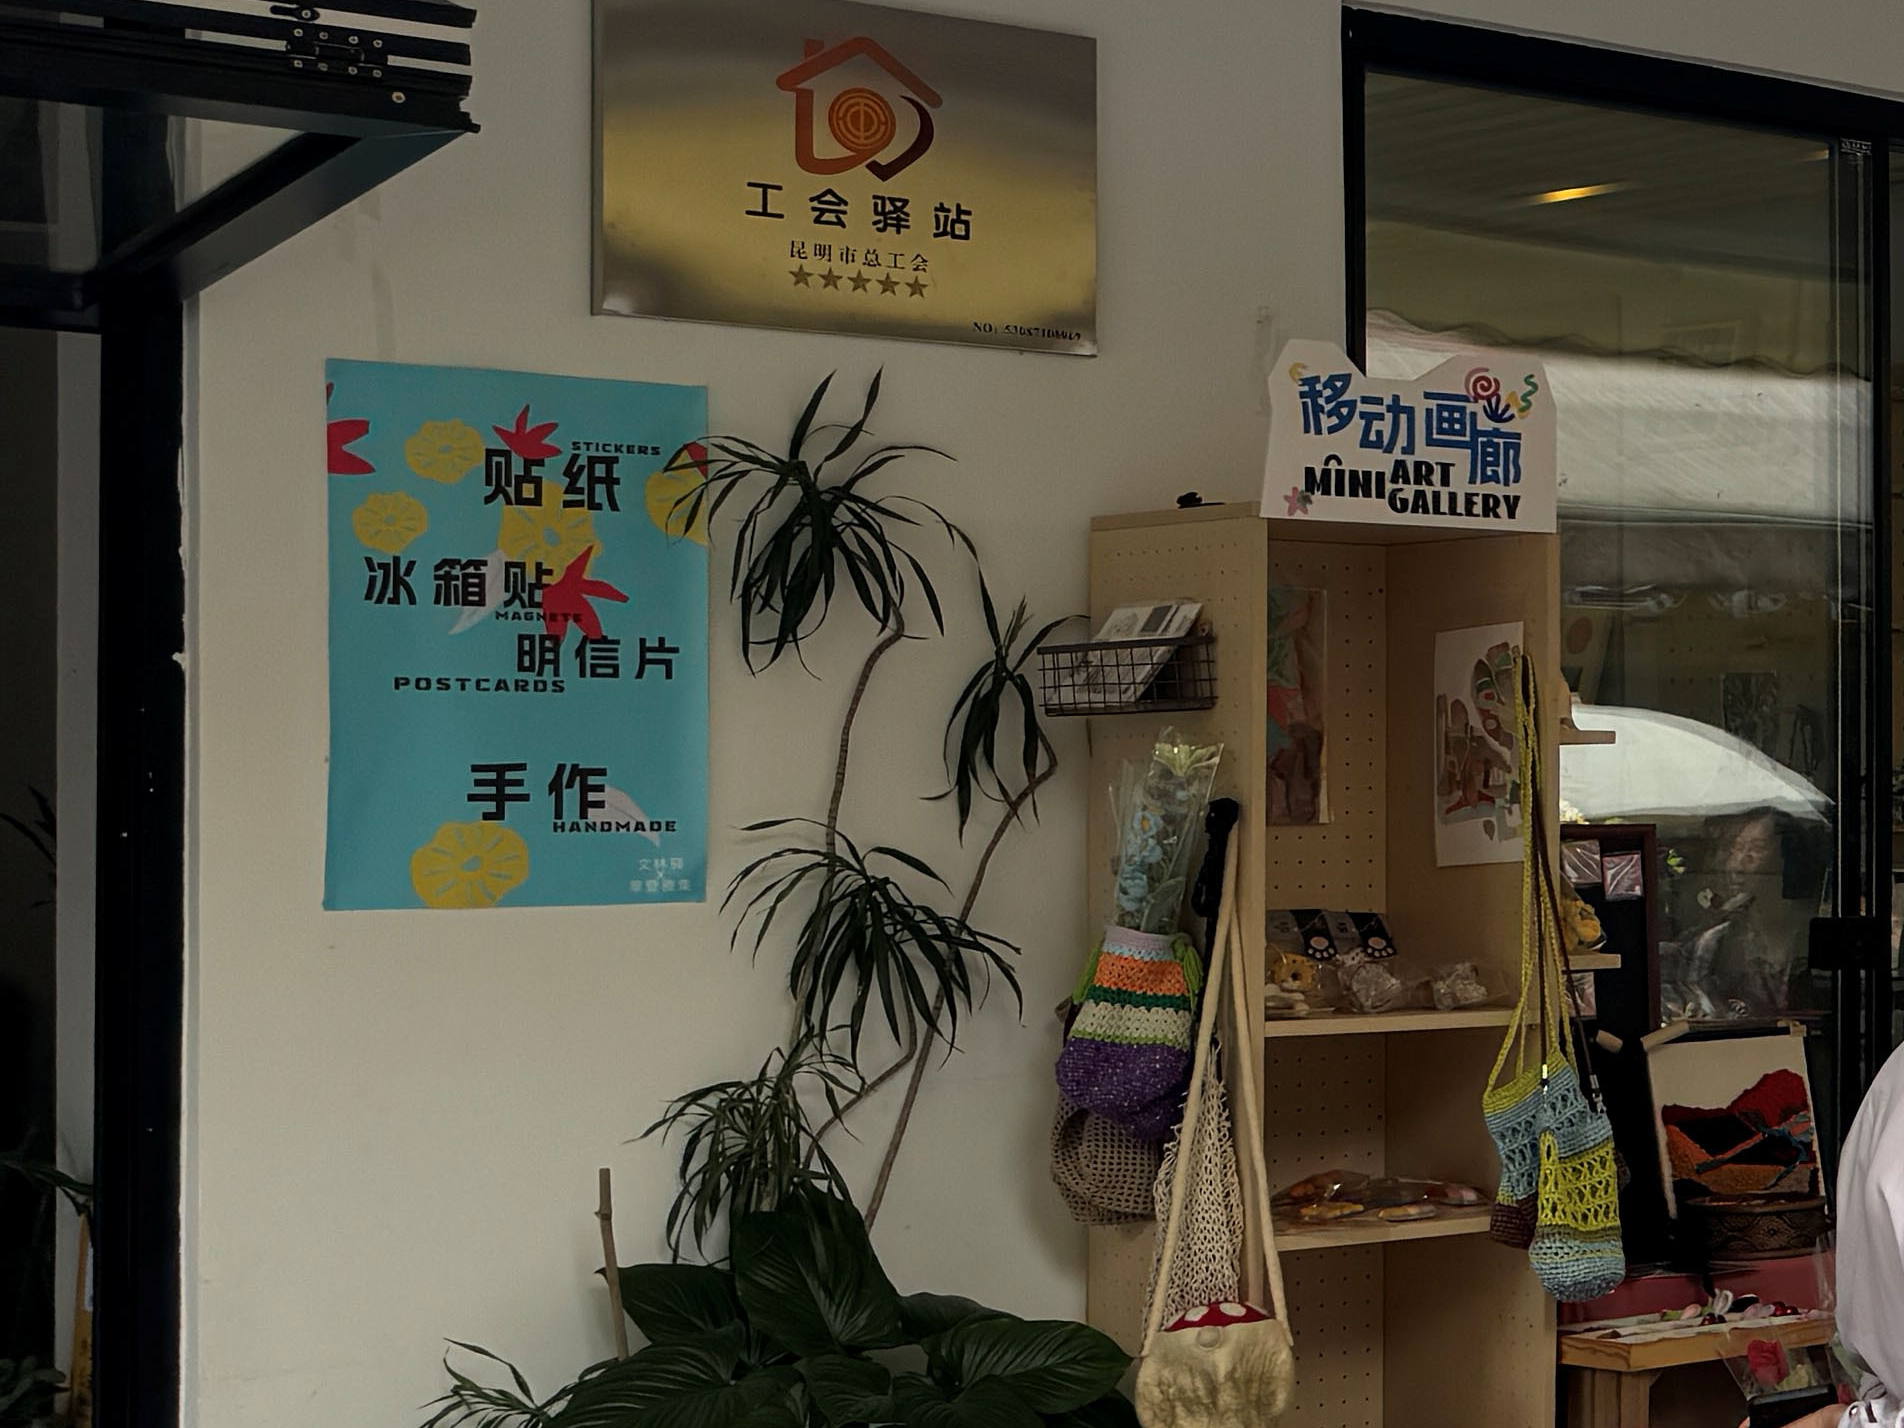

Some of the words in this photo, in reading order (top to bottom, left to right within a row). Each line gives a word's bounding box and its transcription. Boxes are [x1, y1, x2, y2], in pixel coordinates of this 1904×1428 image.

[744, 181, 973, 241] 工会驿站
[789, 240, 930, 273] 昆明市总工会
[571, 440, 661, 456] STICKERS
[1299, 372, 1521, 486] 移动画廊
[483, 447, 621, 512] 贴纸
[1390, 459, 1456, 488] ART
[1387, 487, 1521, 520] GALLERY
[363, 555, 554, 610] 冰箱贴
[517, 633, 680, 680] 明信片
[394, 676, 566, 694] POSTCARDS
[467, 763, 607, 821] 手作
[552, 821, 677, 834] HANDMADE
